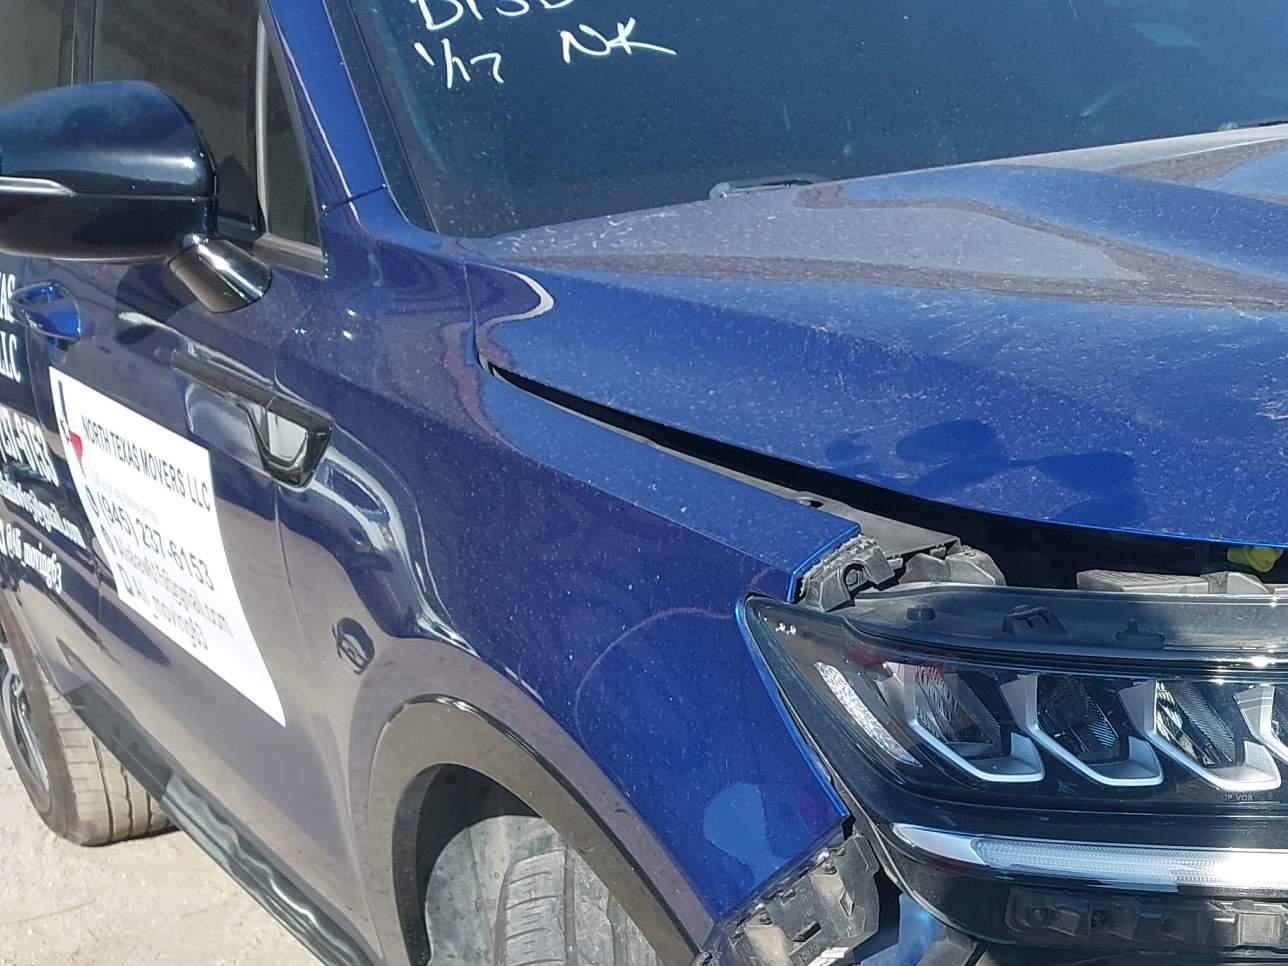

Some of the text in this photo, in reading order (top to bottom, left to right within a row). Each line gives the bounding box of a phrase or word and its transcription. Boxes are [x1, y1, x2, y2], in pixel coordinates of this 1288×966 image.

[81, 415, 112, 455] NORTH
[109, 431, 141, 472] TEXAS
[139, 447, 187, 499] MOVERS
[186, 471, 211, 513] LLC
[135, 517, 215, 592] 237-6153
